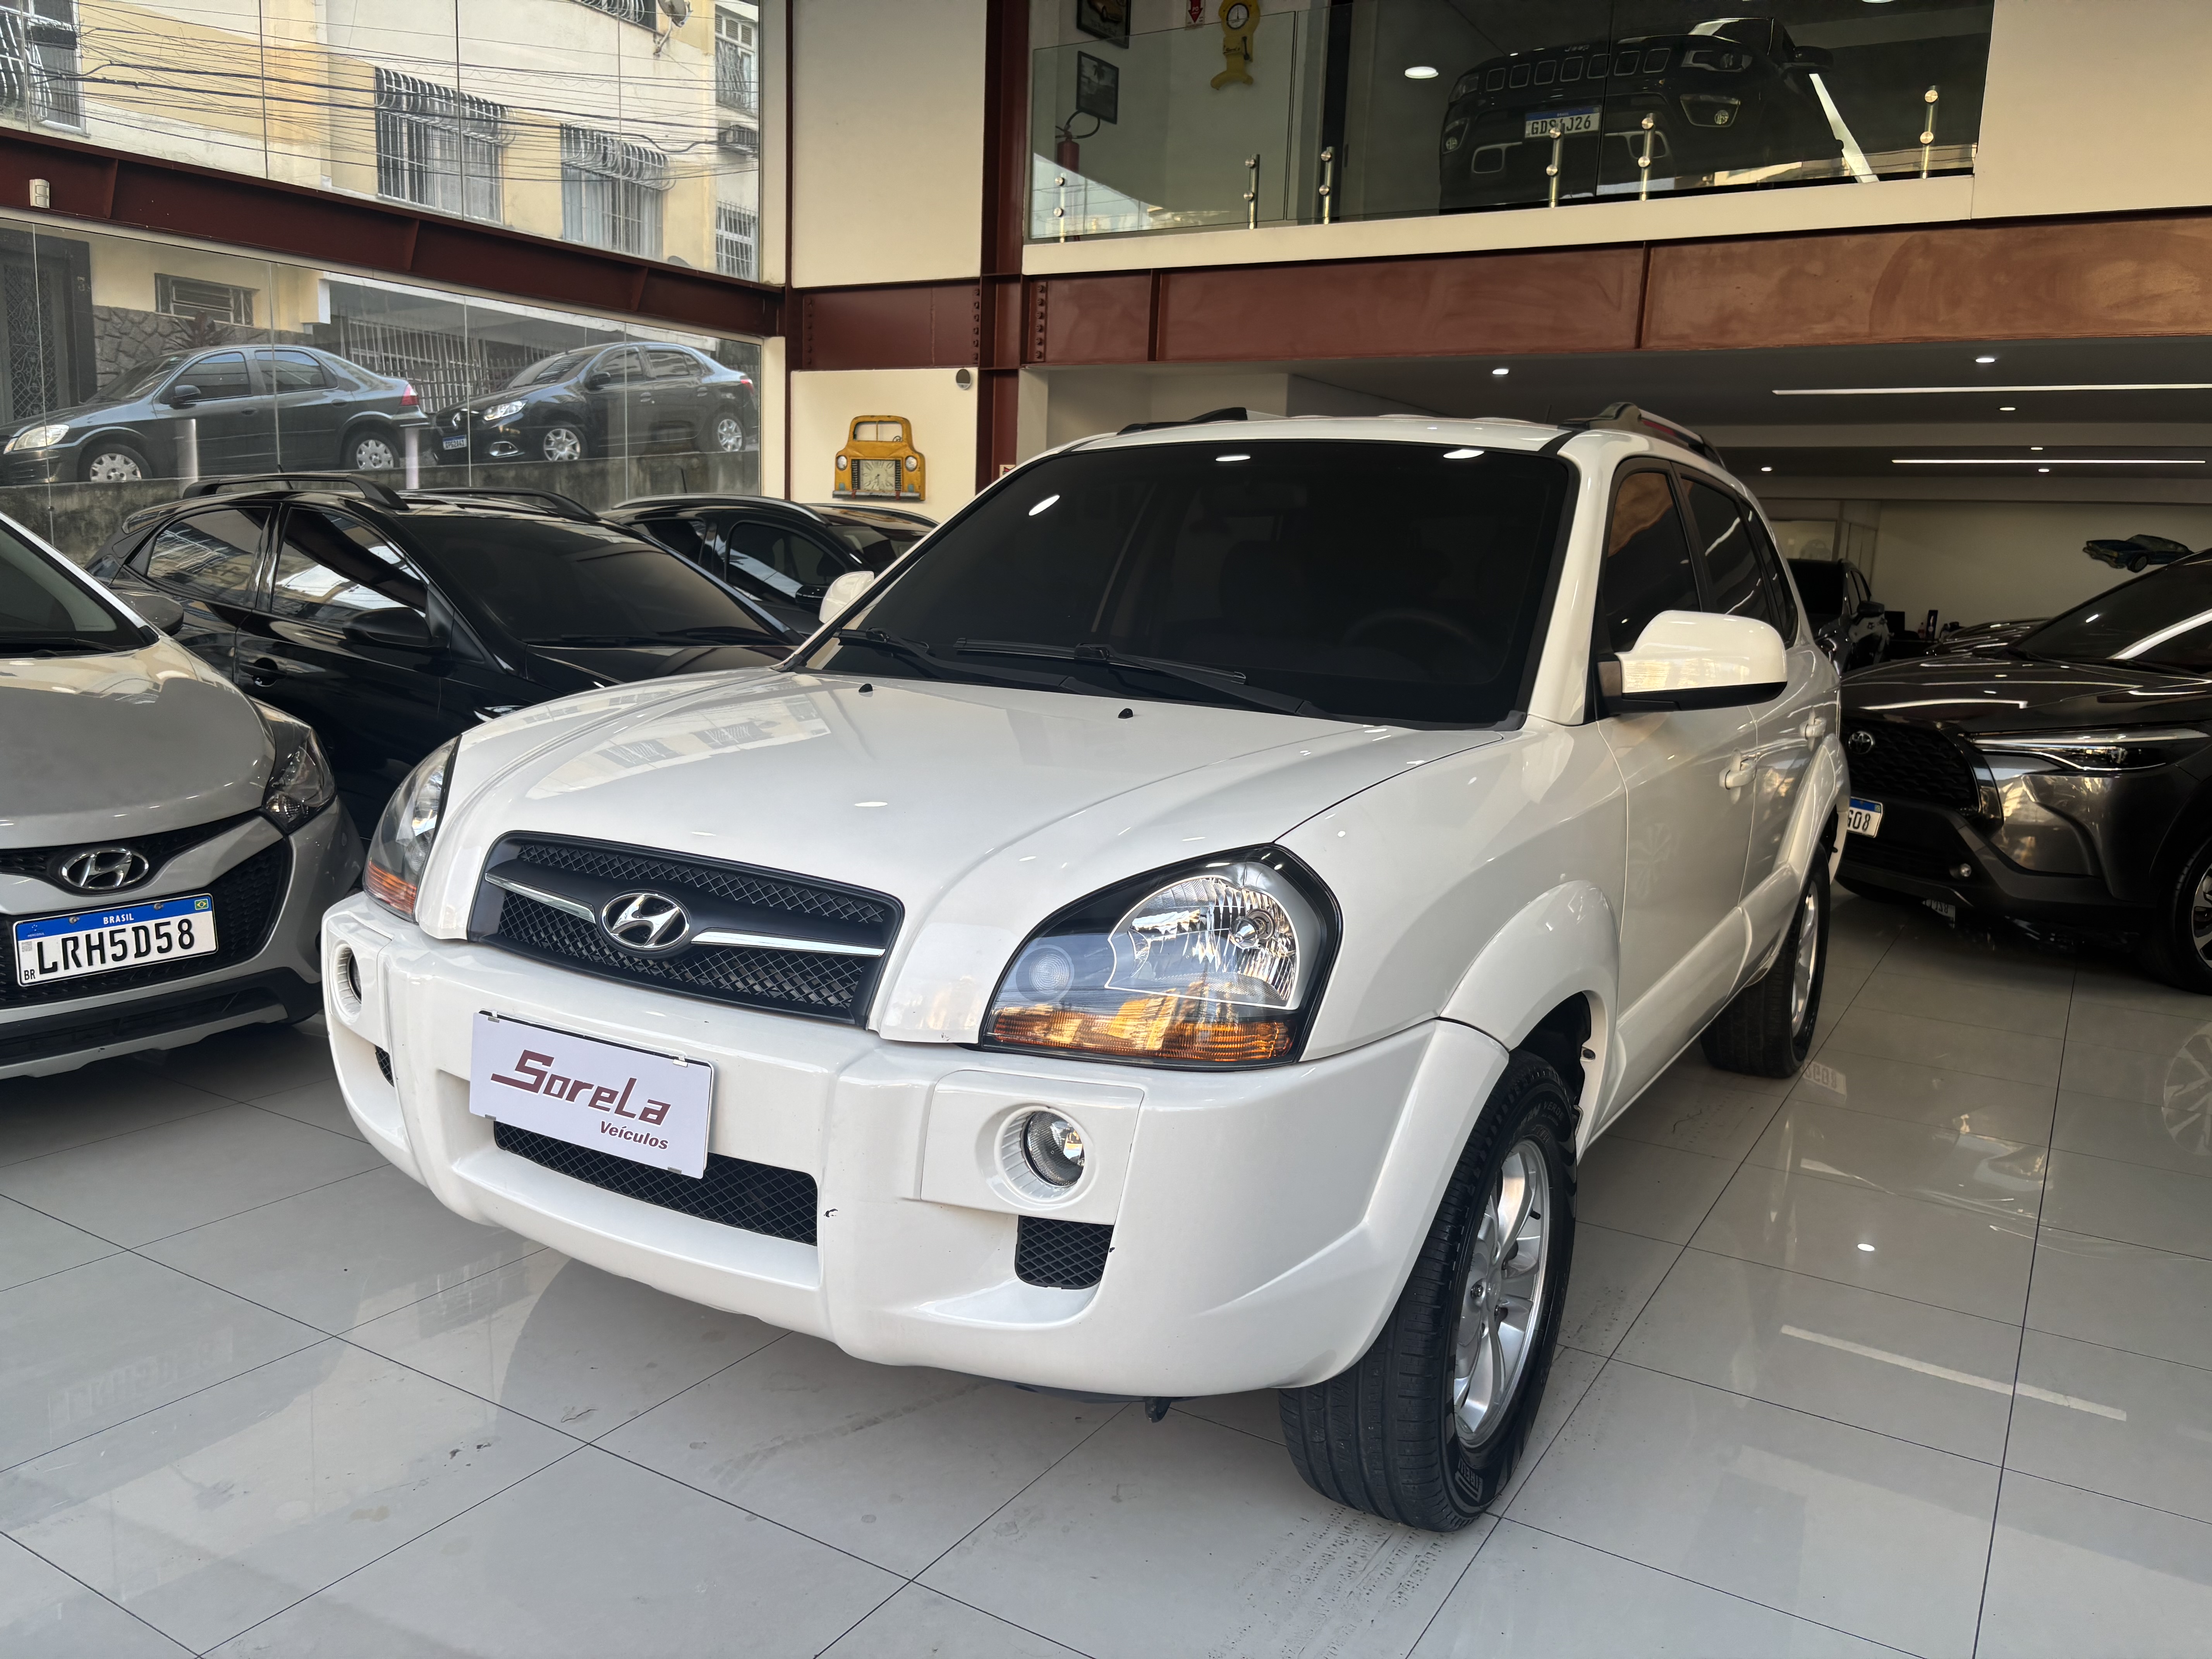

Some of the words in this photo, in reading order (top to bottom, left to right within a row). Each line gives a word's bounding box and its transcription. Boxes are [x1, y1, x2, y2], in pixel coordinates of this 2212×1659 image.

[1531, 115, 1591, 135] GDSJ26
[103, 913, 134, 925] BRASIL
[37, 918, 194, 975] LRH5D58
[24, 969, 36, 981] BR
[600, 1120, 669, 1149] Veículos
